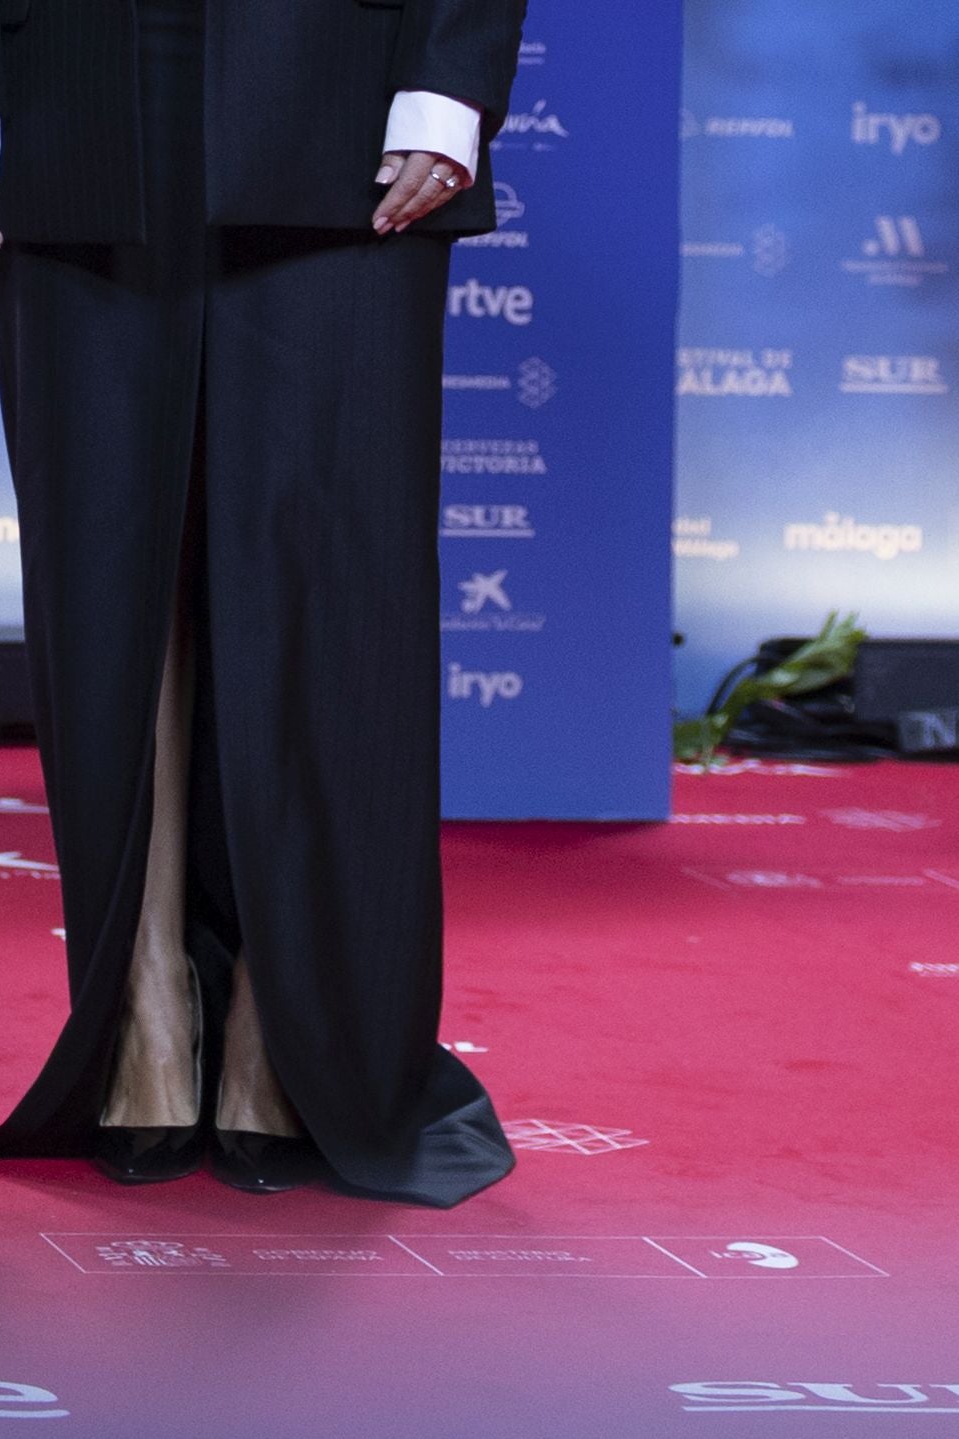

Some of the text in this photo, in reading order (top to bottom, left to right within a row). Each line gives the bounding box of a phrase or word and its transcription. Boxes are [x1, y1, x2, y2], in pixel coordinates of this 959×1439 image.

[851, 101, 940, 155] iryo
[449, 277, 534, 326] rtve
[441, 455, 548, 475] ICTORIA
[443, 504, 531, 529] SUR
[447, 663, 523, 708] iryo
[667, 1381, 959, 1404] SU
